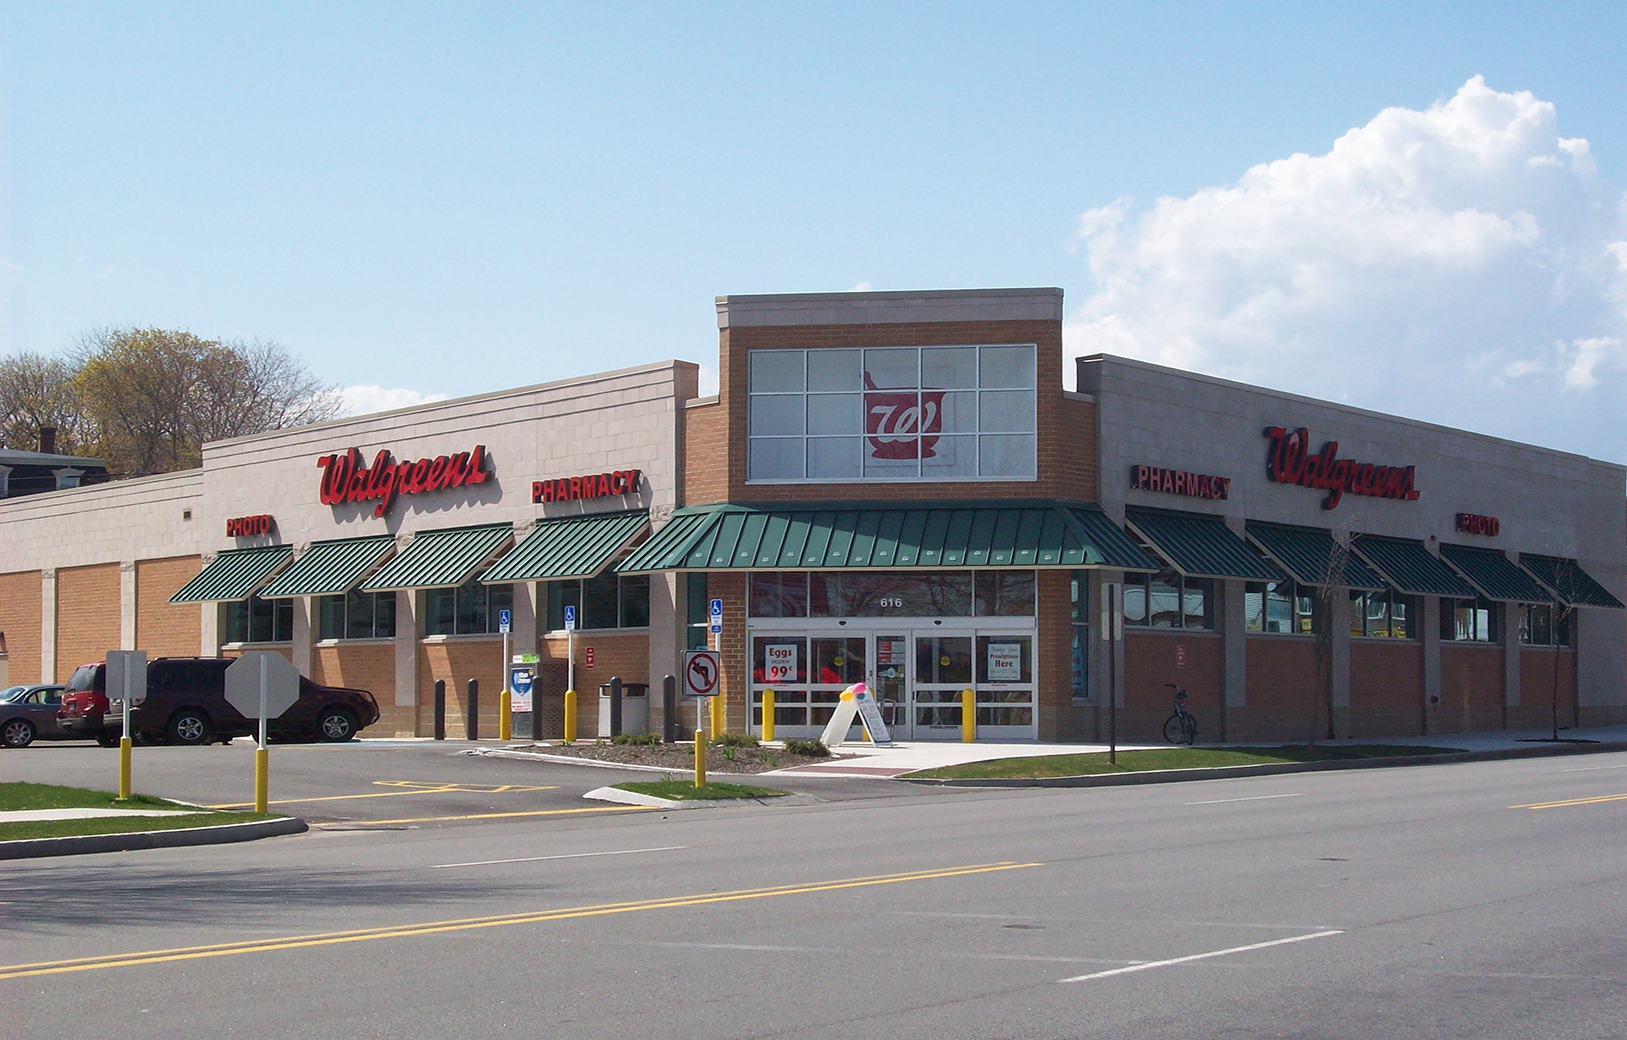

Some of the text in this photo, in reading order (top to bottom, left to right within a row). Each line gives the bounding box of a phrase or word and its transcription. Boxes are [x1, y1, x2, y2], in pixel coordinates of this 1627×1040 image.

[1264, 425, 1421, 510] Walgreens
[316, 445, 488, 518] Walgreens
[531, 469, 642, 504] PHARMACY
[1132, 464, 1232, 501] PHARMACY
[226, 513, 271, 538] PHOTO
[1457, 512, 1501, 537] PHOTO
[880, 597, 903, 608] 616
[769, 647, 793, 659] Eggs
[994, 659, 1014, 668] Here
